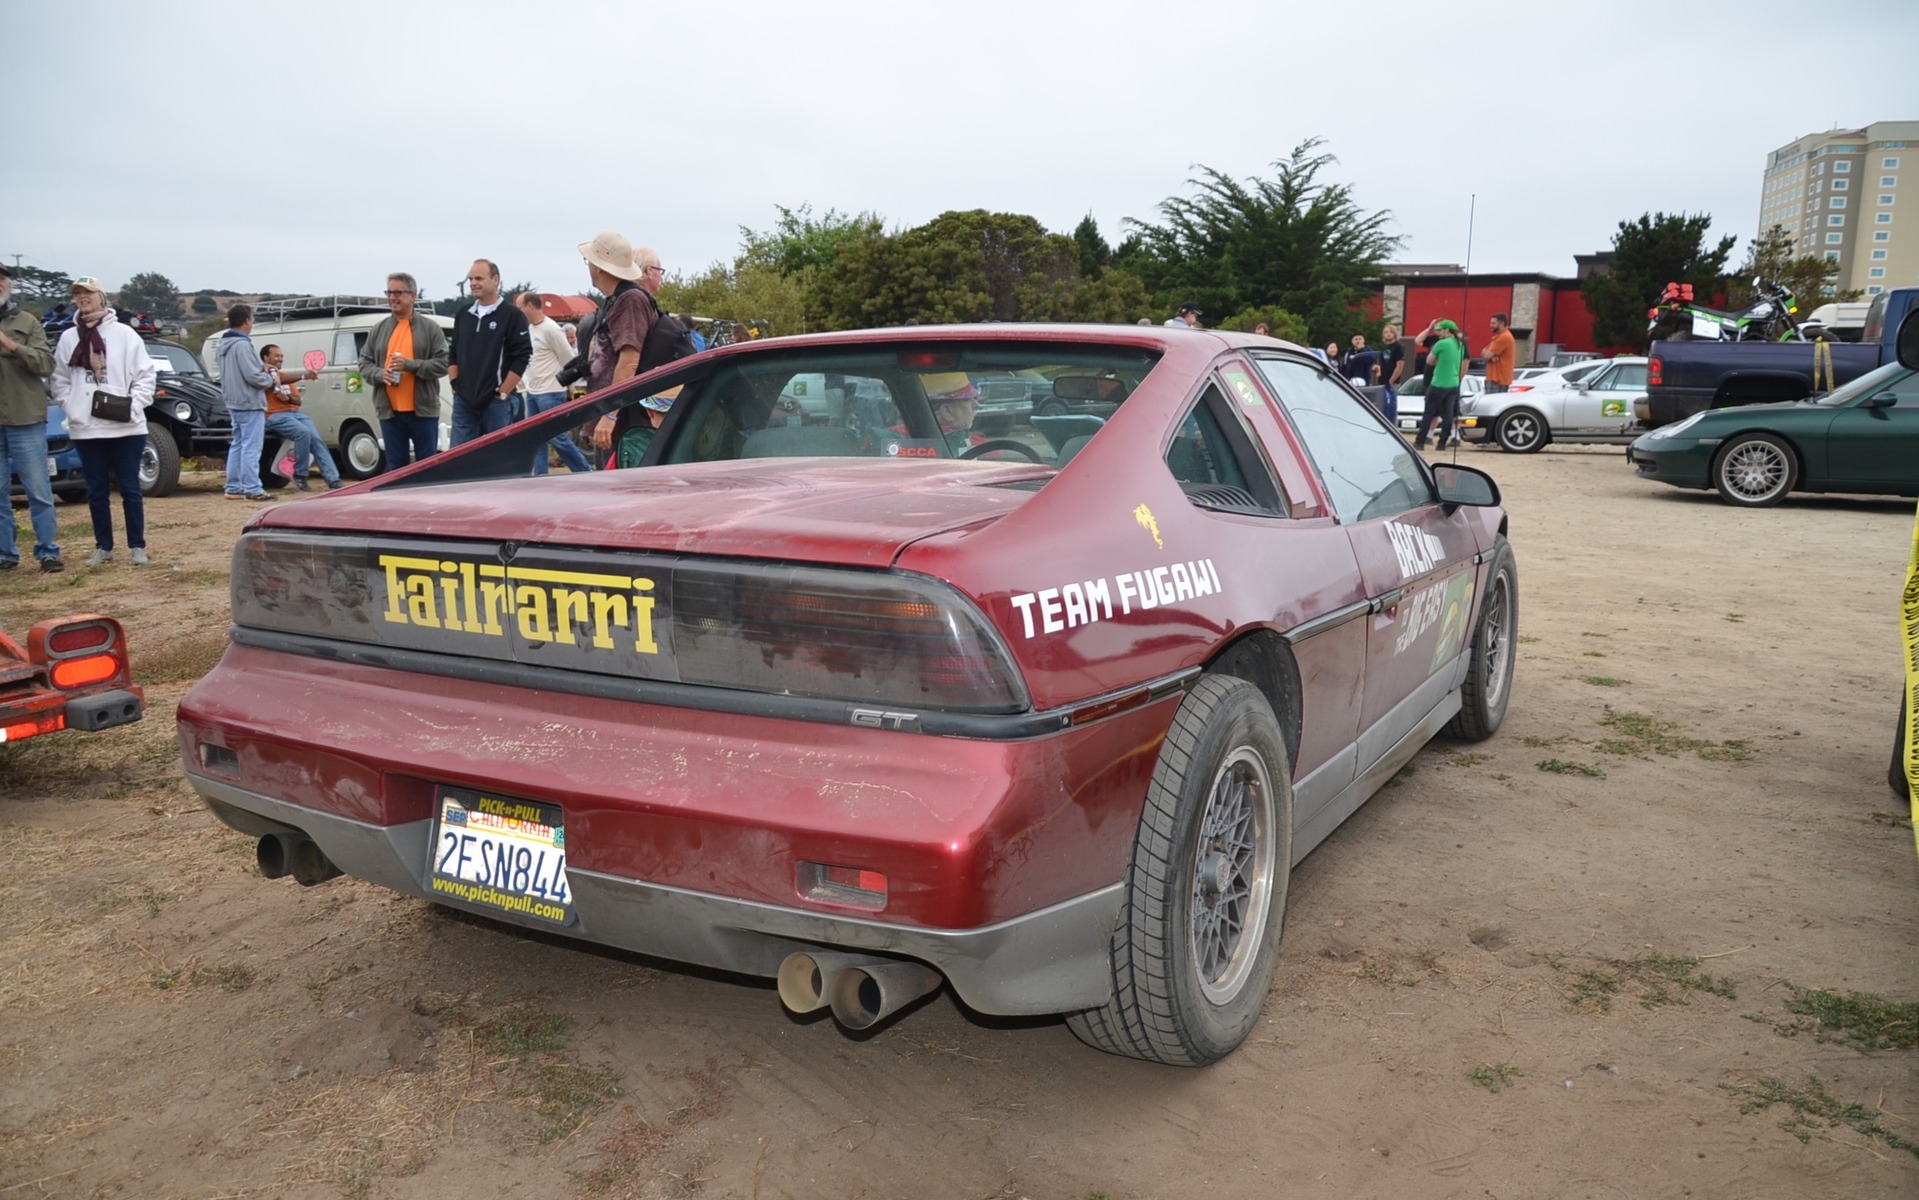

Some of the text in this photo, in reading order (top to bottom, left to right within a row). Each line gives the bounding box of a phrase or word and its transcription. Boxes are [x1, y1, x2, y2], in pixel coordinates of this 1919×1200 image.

[898, 447, 937, 457] SCCA
[1010, 558, 1222, 639] TEAM FUGAWI
[850, 708, 918, 728] GT
[446, 809, 467, 824] SEP
[438, 832, 567, 903] 2FSN844
[432, 877, 565, 921] www.picknpull.com
